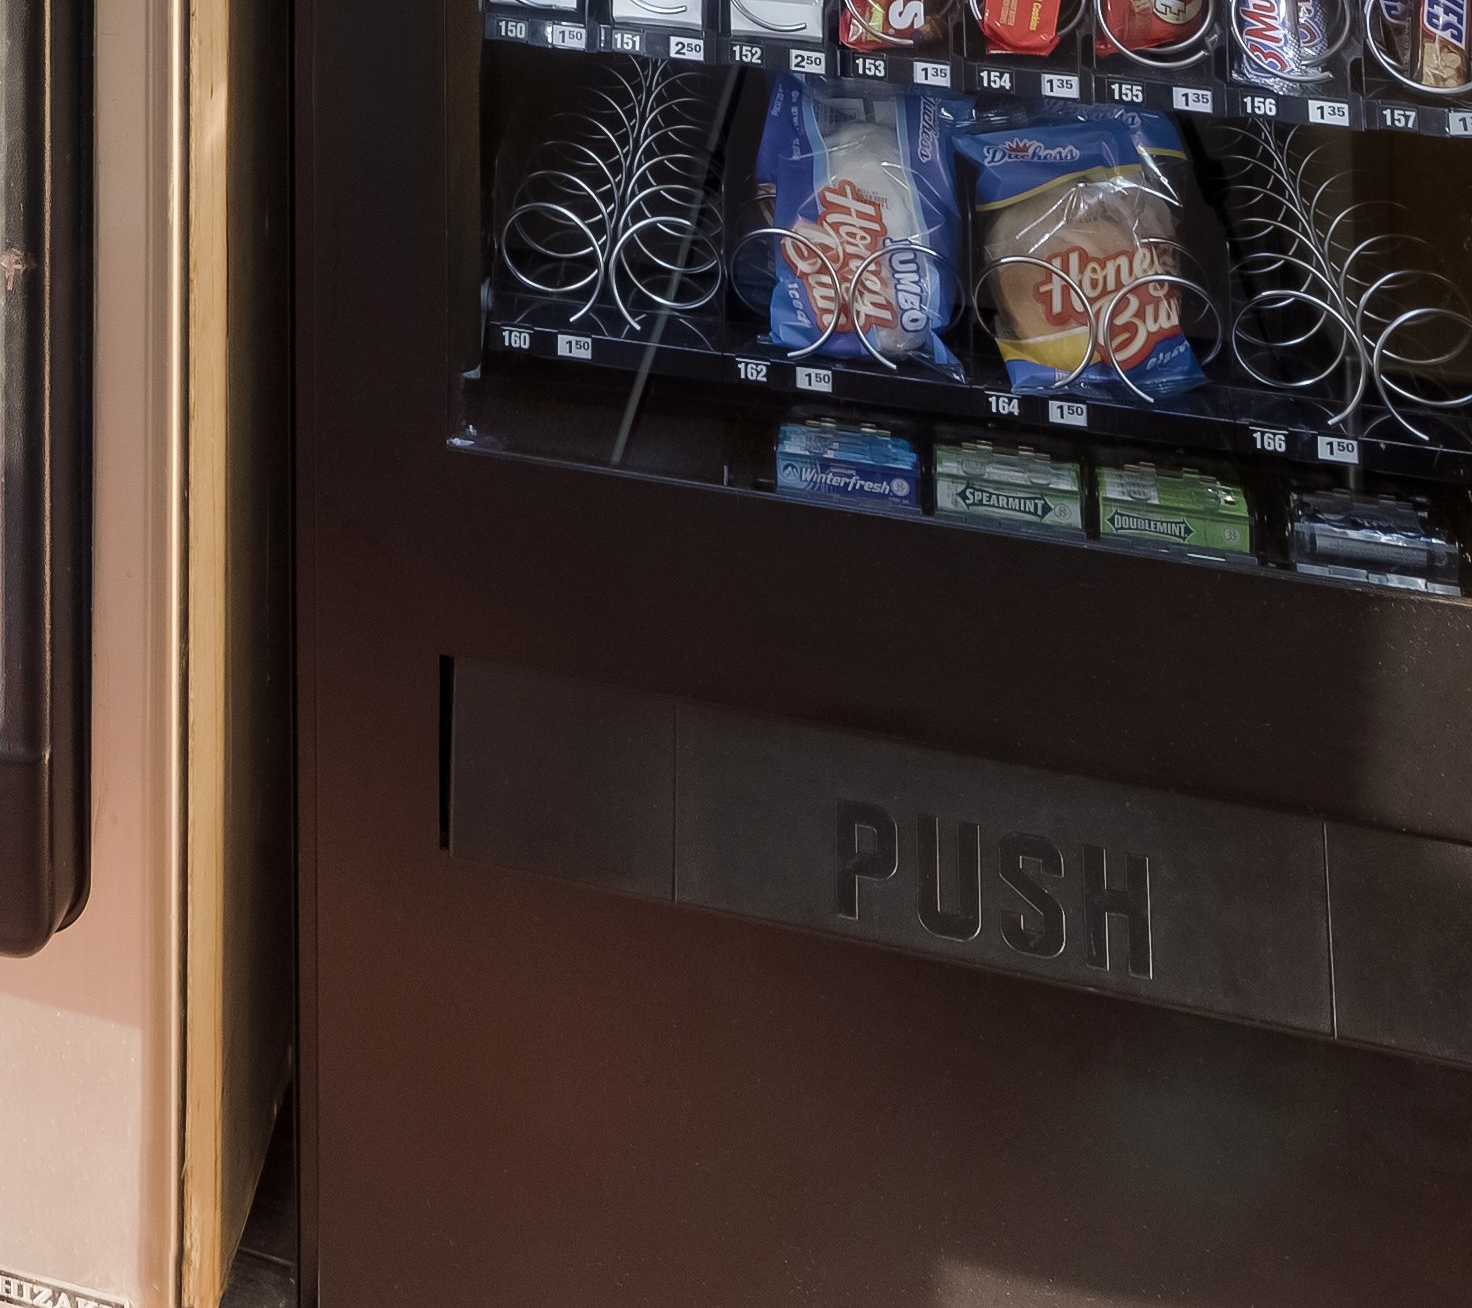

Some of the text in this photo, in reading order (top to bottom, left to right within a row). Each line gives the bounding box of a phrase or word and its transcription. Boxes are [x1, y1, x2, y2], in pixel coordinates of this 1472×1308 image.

[499, 21, 526, 37] 150
[614, 34, 641, 50] 151
[733, 47, 761, 62] 152
[1247, 44, 1288, 73] 3
[856, 60, 885, 76] 153
[980, 72, 1011, 89] 154
[1111, 84, 1143, 102] 155
[1243, 97, 1276, 115] 156
[1383, 109, 1416, 127] 157
[983, 143, 1080, 166] Duchess
[883, 236, 929, 333] JUMBO
[502, 330, 530, 349] 160
[738, 362, 767, 380] 162
[989, 397, 1019, 416] 164
[1253, 432, 1286, 451] 166
[800, 469, 892, 497] Winterfresh
[964, 488, 1046, 517] SPEARMINT
[1113, 513, 1187, 538] DOUBLEMINT
[835, 795, 1154, 981] PUSH
